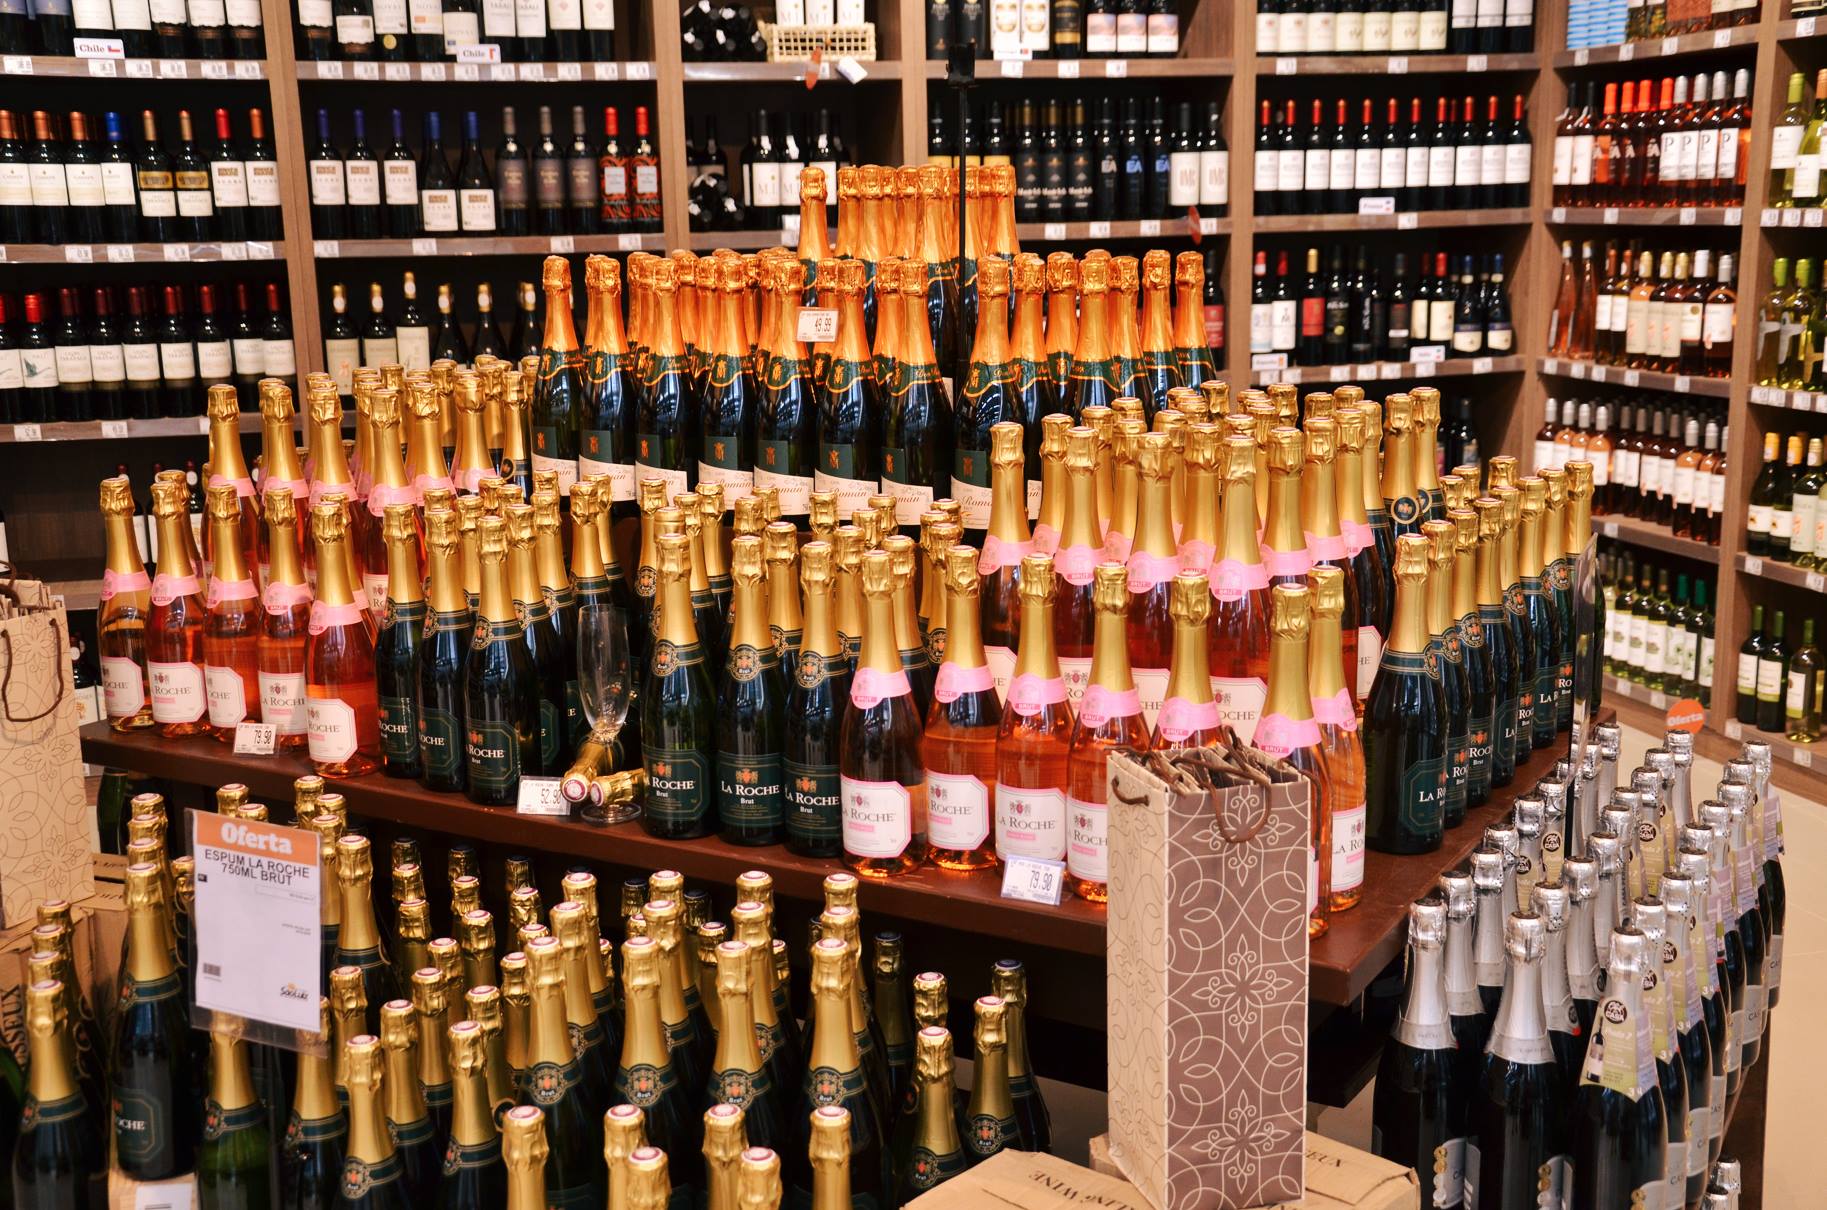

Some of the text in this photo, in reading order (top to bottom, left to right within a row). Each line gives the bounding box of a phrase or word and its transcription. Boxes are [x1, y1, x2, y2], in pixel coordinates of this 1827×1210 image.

[79, 44, 105, 53] Chile
[462, 48, 485, 58] Chile
[1220, 710, 1256, 721] OCHE
[1666, 711, 1704, 728] Oferta
[419, 733, 445, 746] OCHE
[469, 744, 505, 758] ROCHE
[652, 776, 695, 790] ROCHE
[721, 780, 780, 796] LA ROCHE
[740, 797, 754, 805] Brut
[796, 792, 839, 806] ROCHE
[1419, 791, 1434, 802] LA
[851, 810, 894, 823] ROCHE
[1009, 818, 1056, 830] ROCHE
[220, 821, 293, 855] Oferta
[1074, 830, 1108, 844] ROCH
[204, 848, 310, 879] ESPUM LA ROCHE
[221, 862, 293, 886] 750ML BRUT
[1029, 1170, 1078, 1200] WINE
